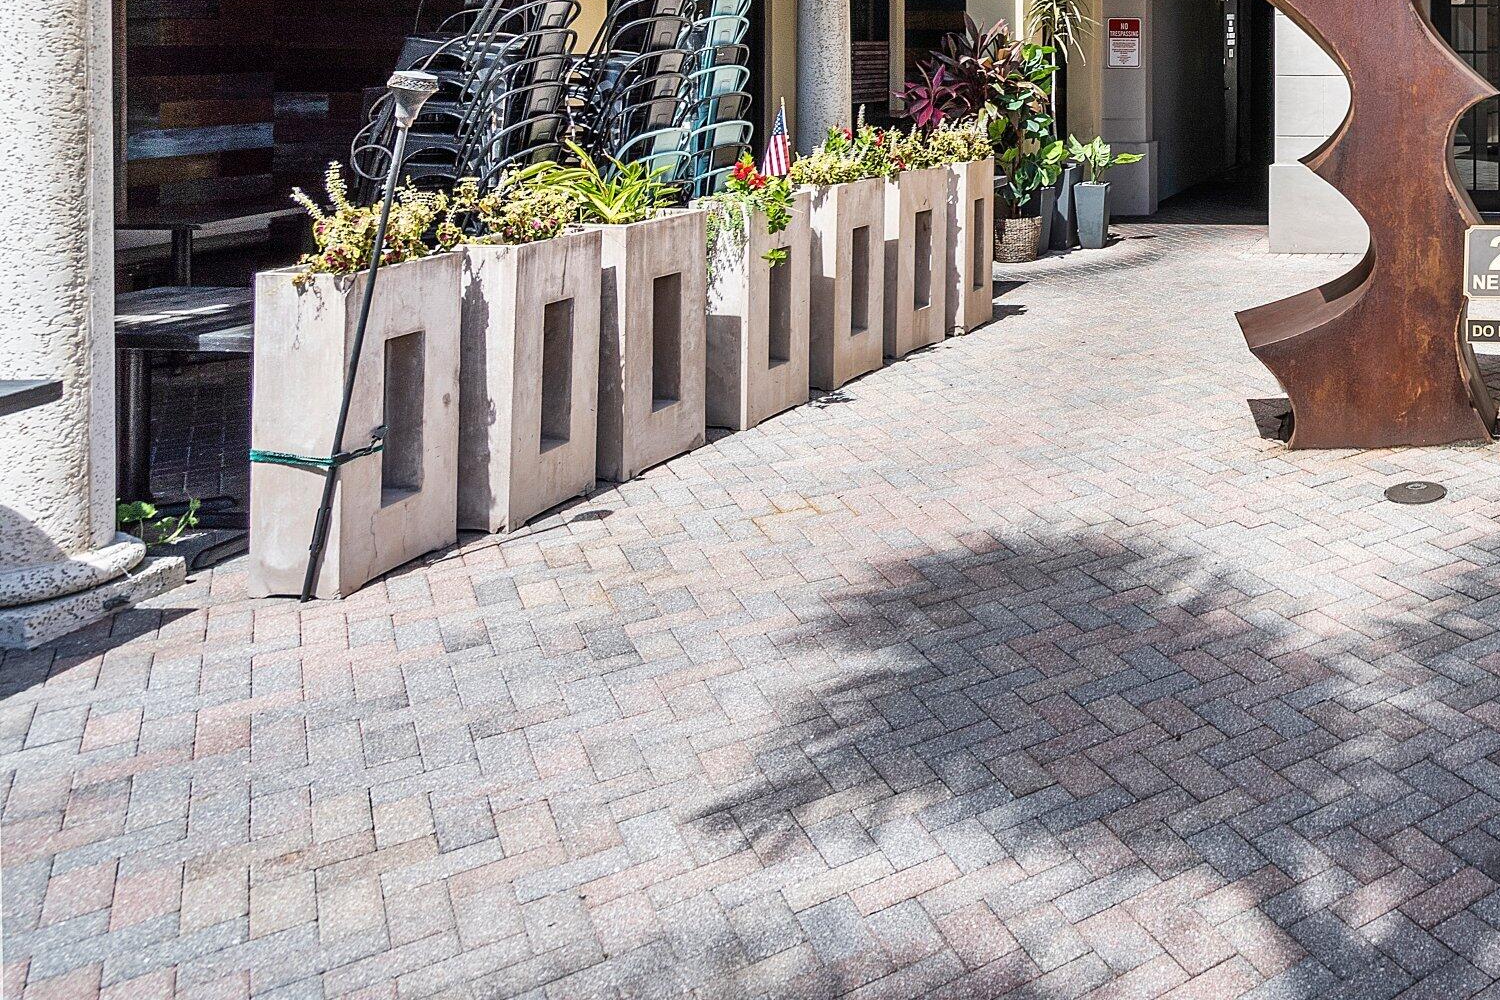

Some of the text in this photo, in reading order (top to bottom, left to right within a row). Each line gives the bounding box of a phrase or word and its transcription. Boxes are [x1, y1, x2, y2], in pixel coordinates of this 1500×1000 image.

[1120, 22, 1129, 30] NO
[1472, 274, 1499, 290] NE
[1472, 324, 1495, 338] DO
